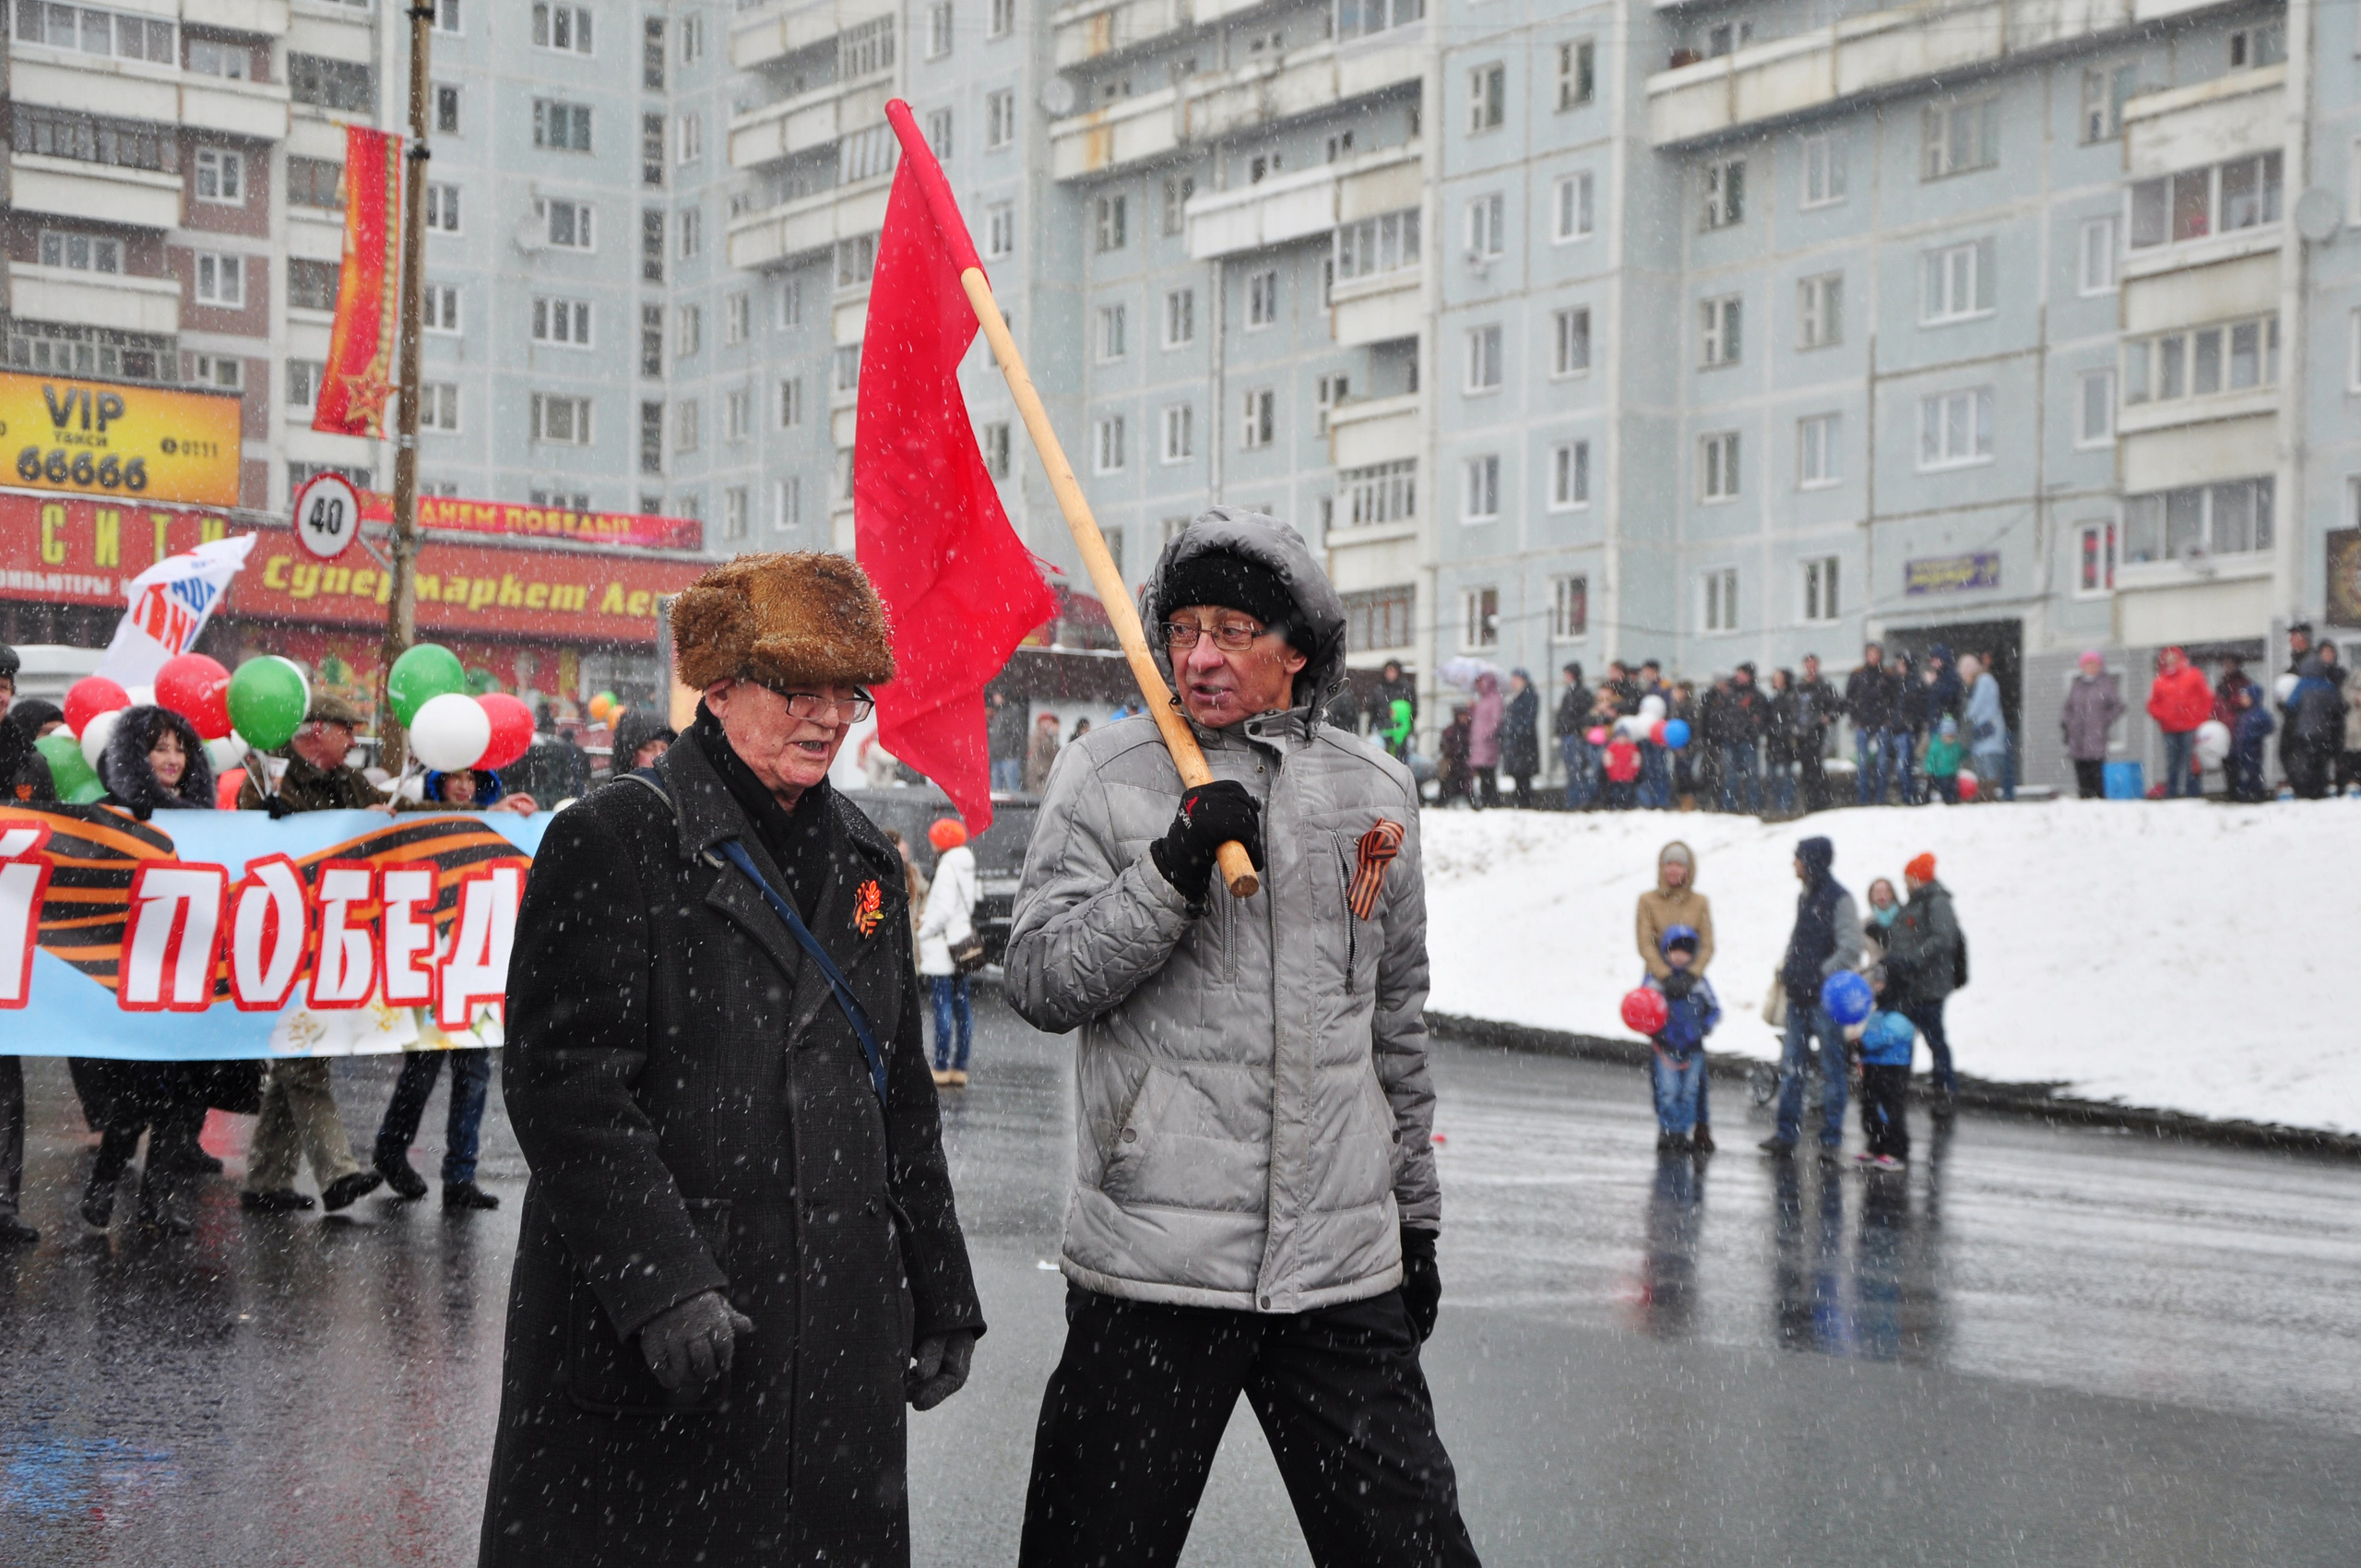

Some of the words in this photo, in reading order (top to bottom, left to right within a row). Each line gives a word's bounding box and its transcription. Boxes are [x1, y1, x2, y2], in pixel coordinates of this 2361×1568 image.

[42, 385, 125, 433] VIP
[18, 446, 148, 492] 66666
[309, 496, 343, 535] 40
